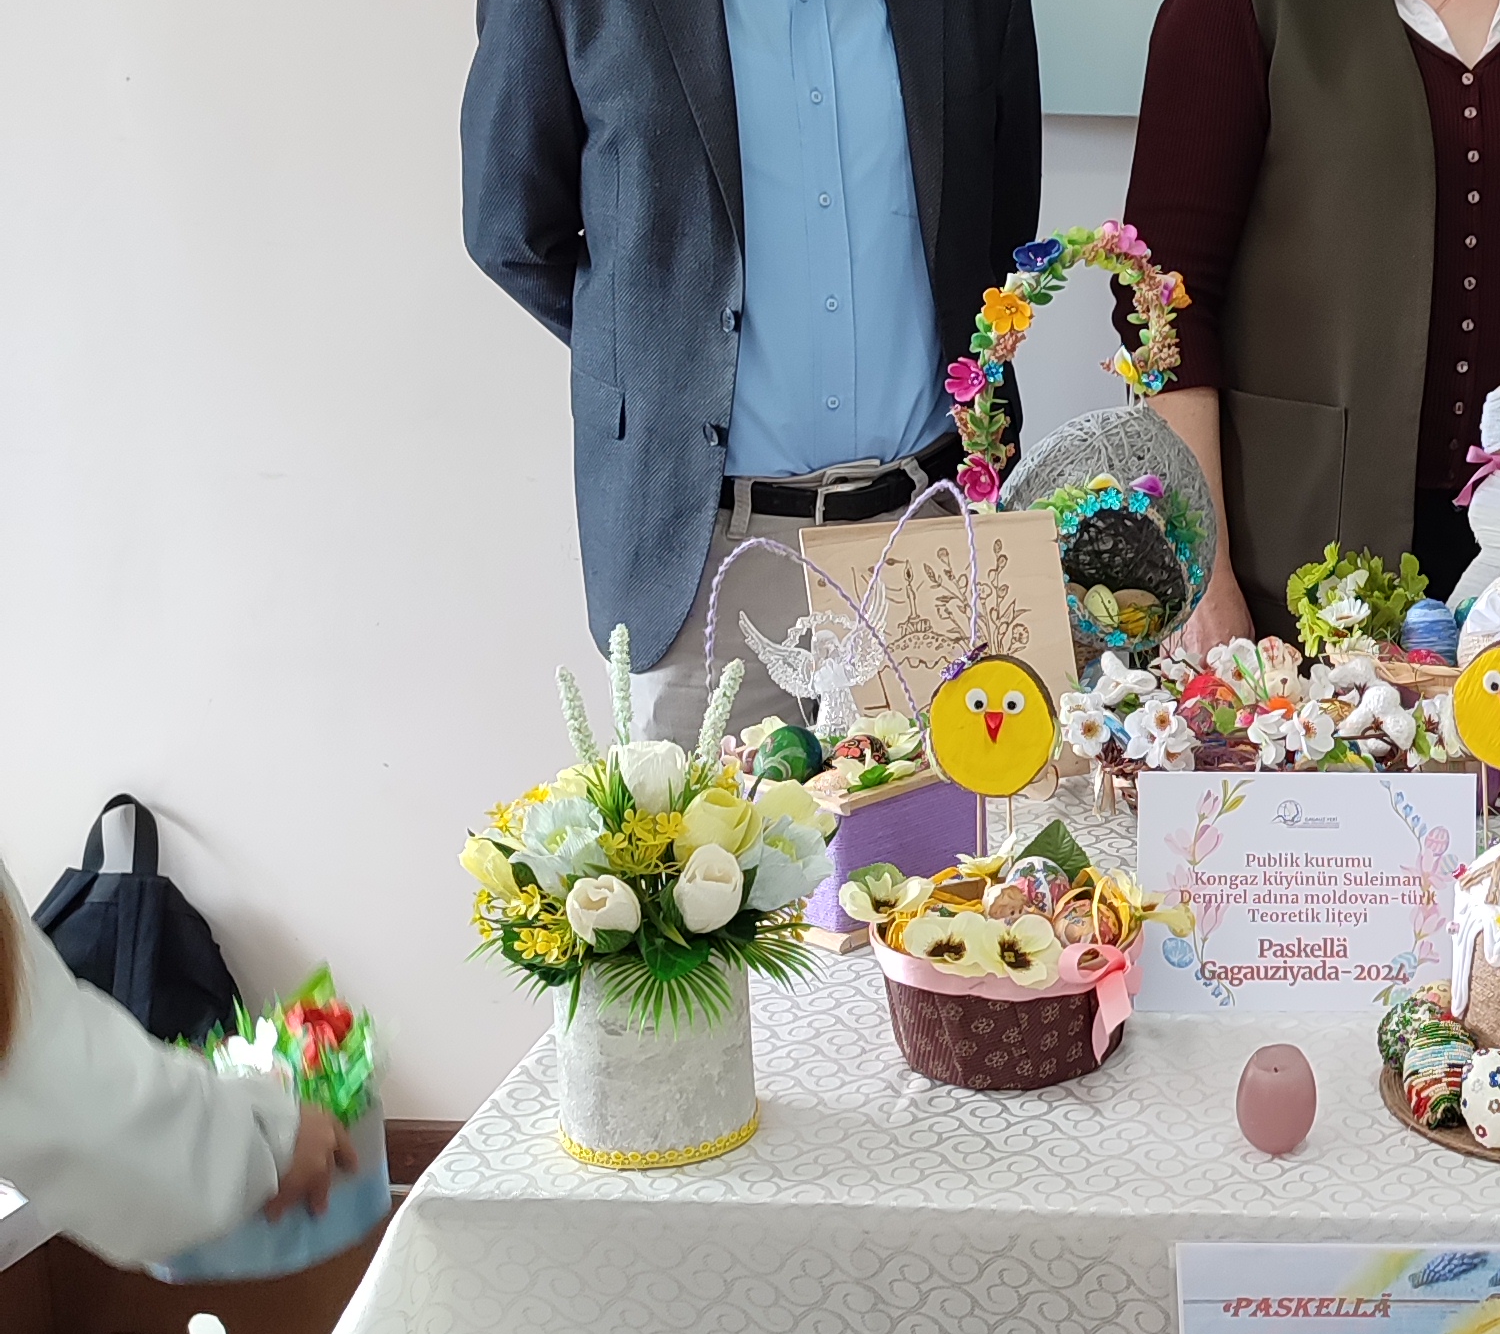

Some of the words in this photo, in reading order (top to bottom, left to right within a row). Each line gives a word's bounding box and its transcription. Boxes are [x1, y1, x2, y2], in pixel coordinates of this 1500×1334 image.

[1245, 852, 1301, 868] Publik
[1304, 852, 1373, 868] kurumu
[1194, 871, 1259, 890] Kongaz
[1262, 870, 1339, 890] küyünün
[1343, 871, 1423, 887] Suleiman
[1179, 888, 1248, 905] Demirel
[1252, 889, 1300, 905] adına
[1303, 889, 1438, 906] moldovan-türk
[1247, 907, 1322, 923] Teoretik
[1257, 936, 1350, 959] Paskellä
[1200, 958, 1411, 987] Gagauziyada-2024
